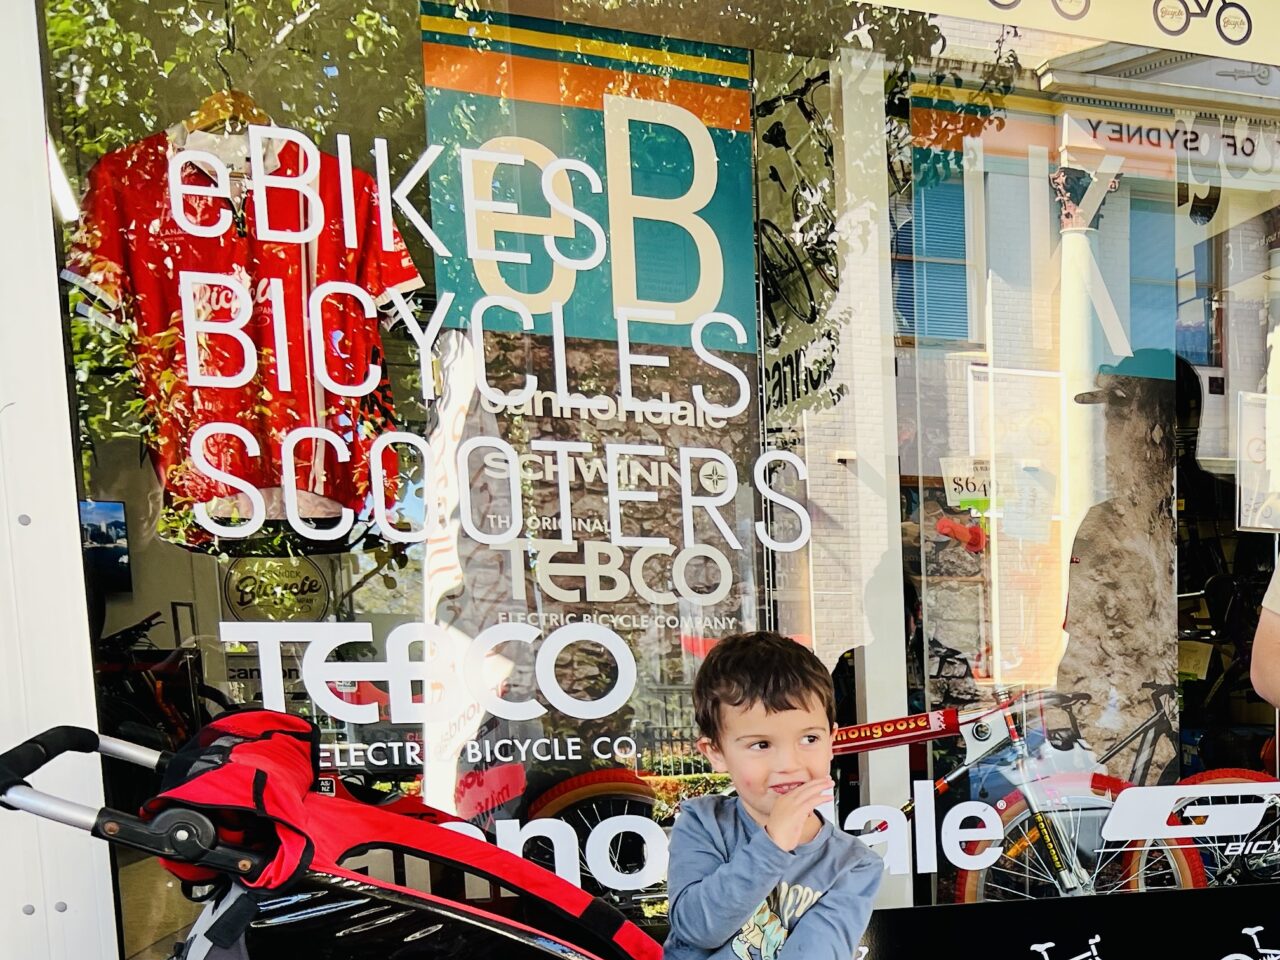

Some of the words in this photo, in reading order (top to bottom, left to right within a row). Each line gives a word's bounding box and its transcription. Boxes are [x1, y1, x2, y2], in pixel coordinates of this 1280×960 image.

[168, 124, 607, 271] eBIKES
[474, 93, 726, 327] eB
[179, 269, 752, 419] BICYCLES
[189, 422, 813, 554] SCOOTERS
[489, 538, 733, 606] TEBCO
[497, 612, 577, 627] ELECTRIC
[582, 613, 649, 629] BICYCLE
[654, 614, 736, 631] COMPANY
[467, 738, 582, 763] BICYCLE
[592, 736, 642, 760] CO.
